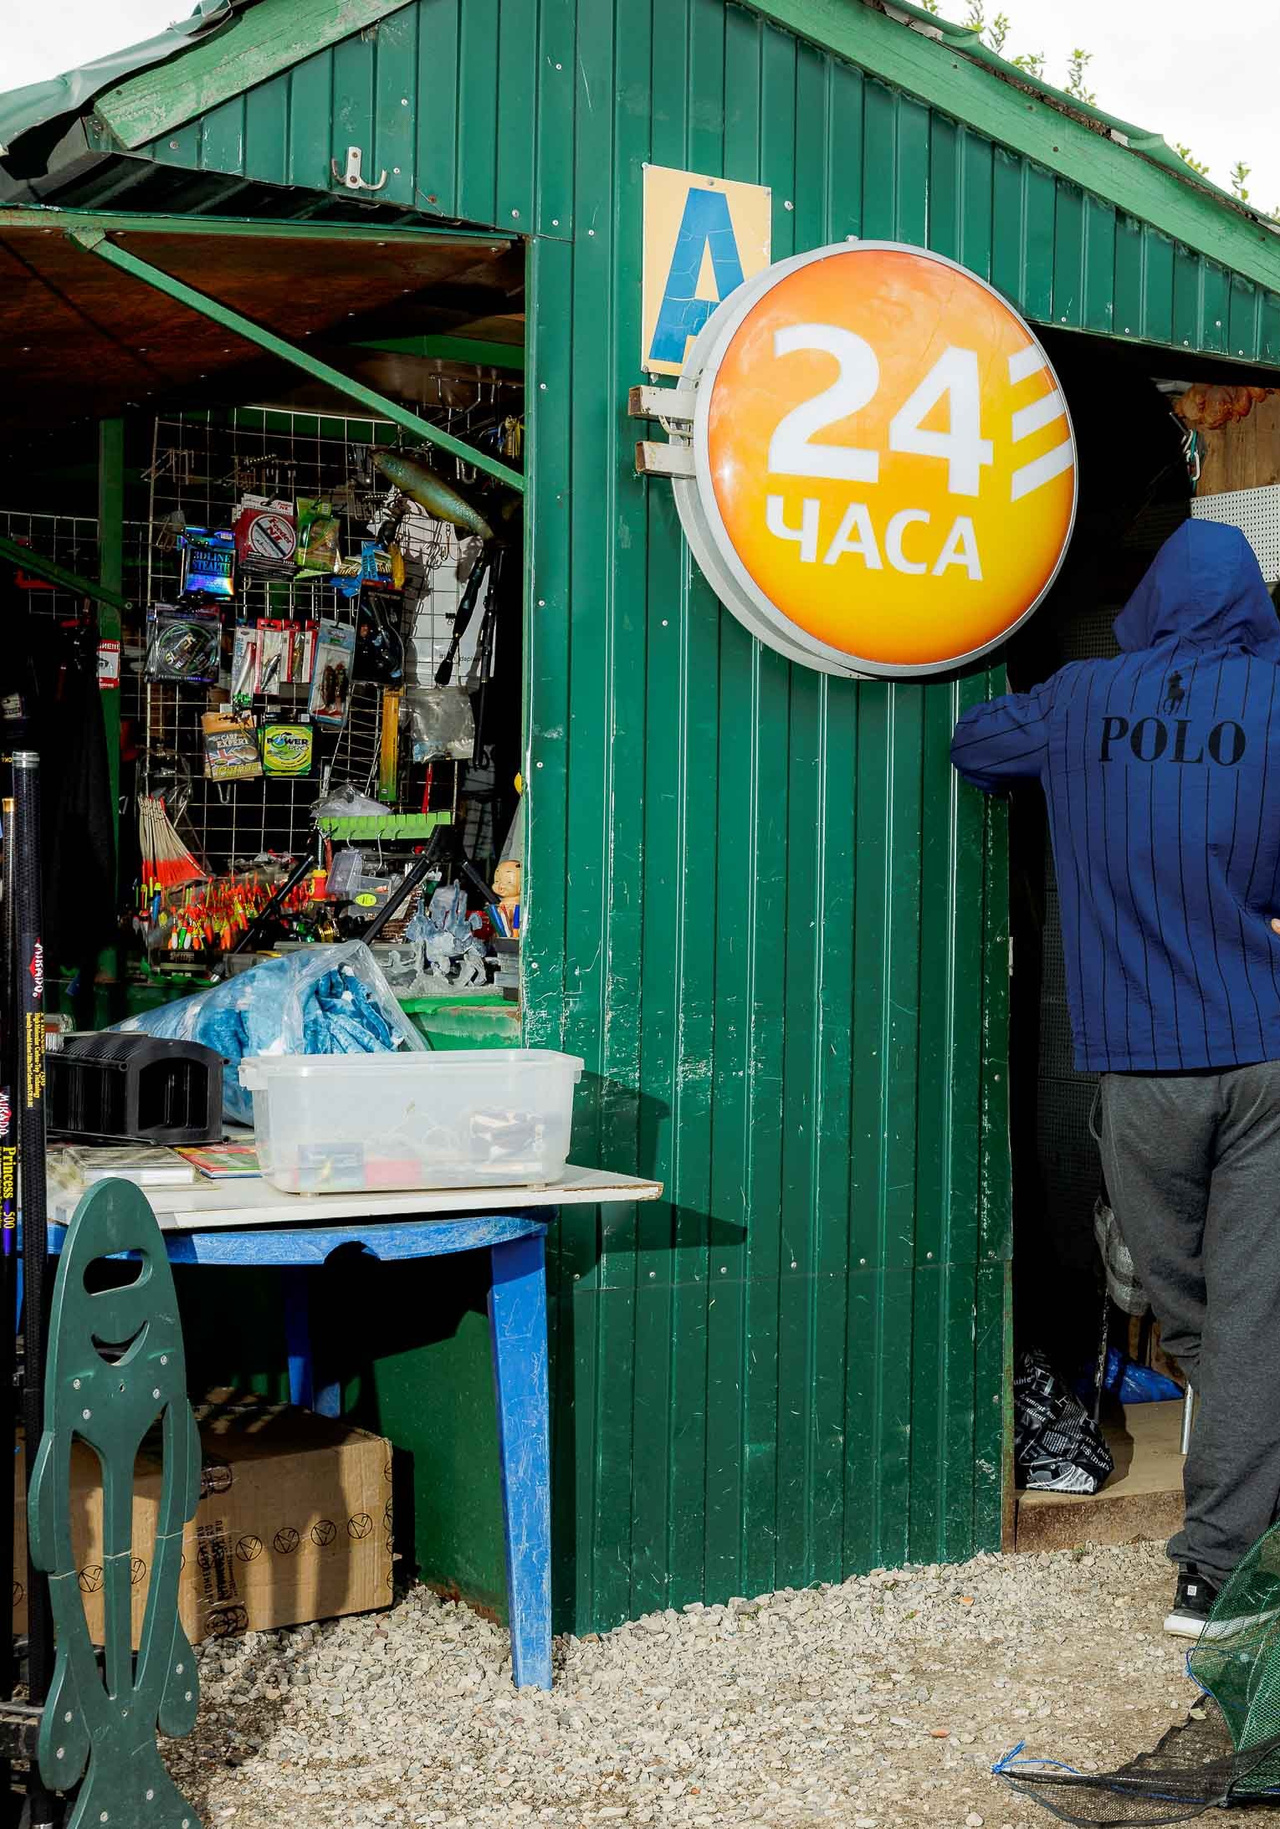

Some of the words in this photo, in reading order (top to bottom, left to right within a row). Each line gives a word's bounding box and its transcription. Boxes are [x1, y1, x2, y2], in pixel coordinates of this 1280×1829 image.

[767, 323, 994, 497] 24
[268, 517, 293, 543] Feeder
[766, 495, 983, 581] ЧАСА
[192, 560, 231, 574] STEALTH
[216, 739, 249, 749] EXPERT
[267, 735, 309, 747] POWER
[1098, 716, 1246, 767] POLO
[34, 942, 44, 993] MIKADO
[3, 1146, 17, 1199] Princess
[3, 1211, 16, 1229] 500
